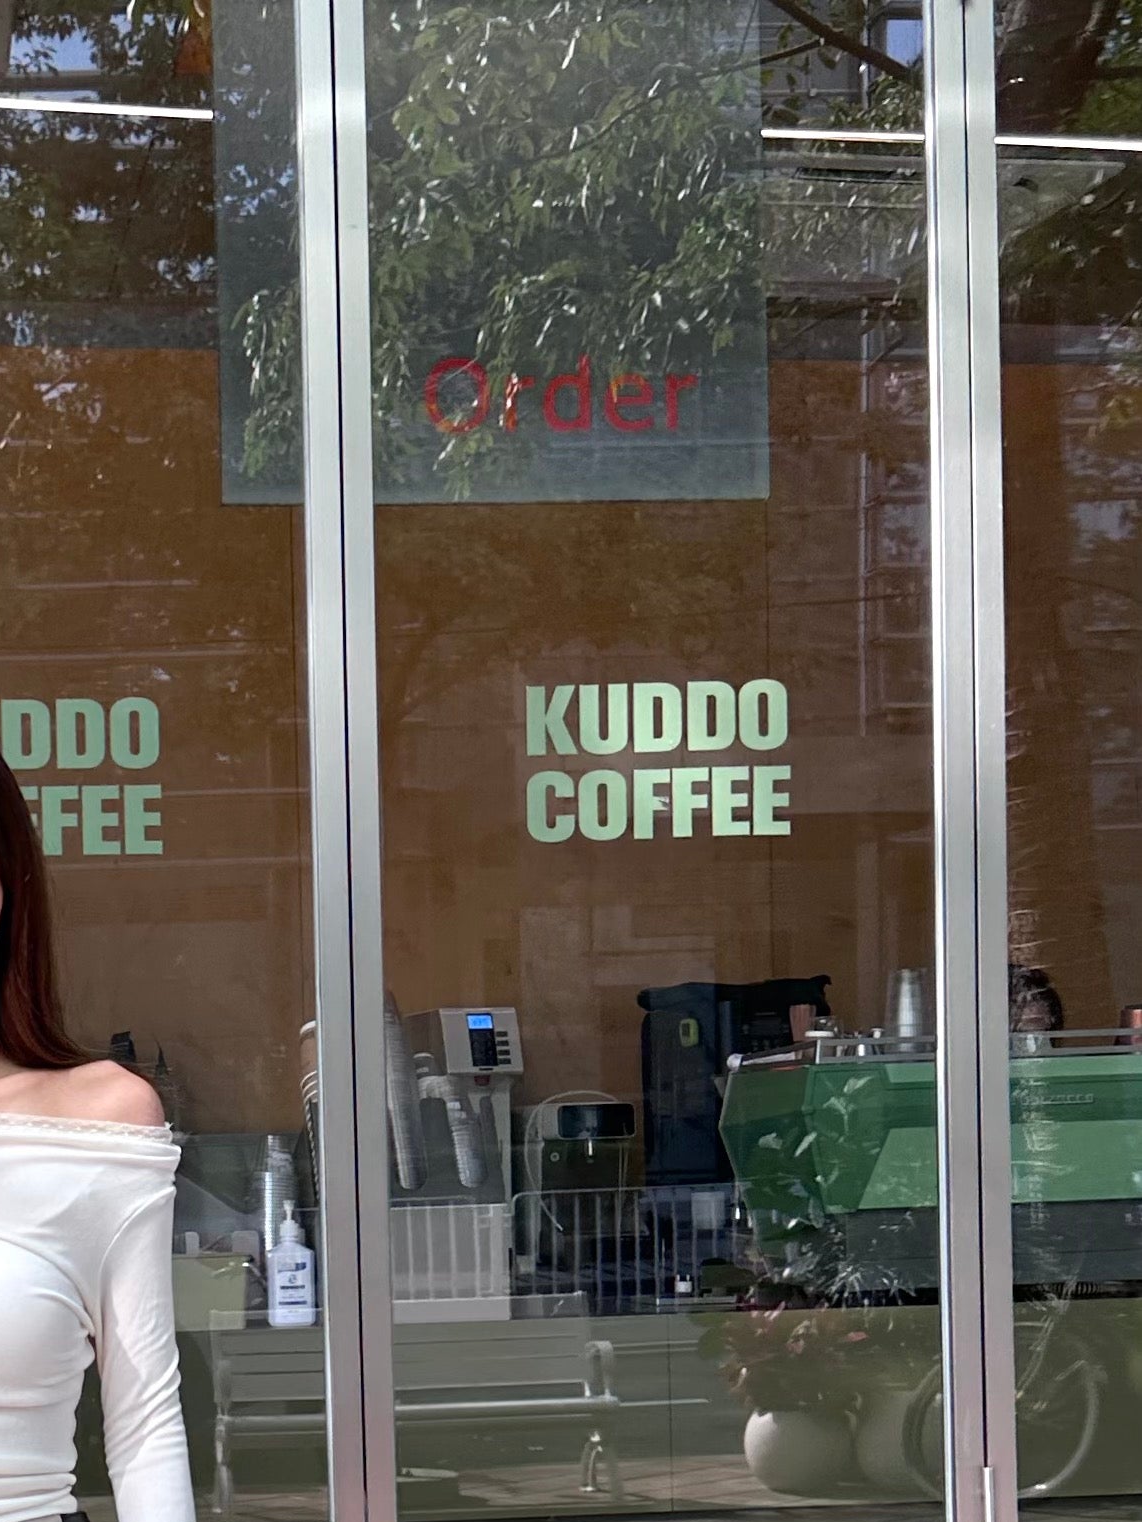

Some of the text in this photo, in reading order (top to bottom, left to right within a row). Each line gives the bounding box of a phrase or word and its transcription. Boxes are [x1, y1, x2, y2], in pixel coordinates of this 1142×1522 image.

[424, 353, 699, 434] Order
[526, 679, 788, 756] KUDDO
[526, 765, 791, 843] COFFEE
